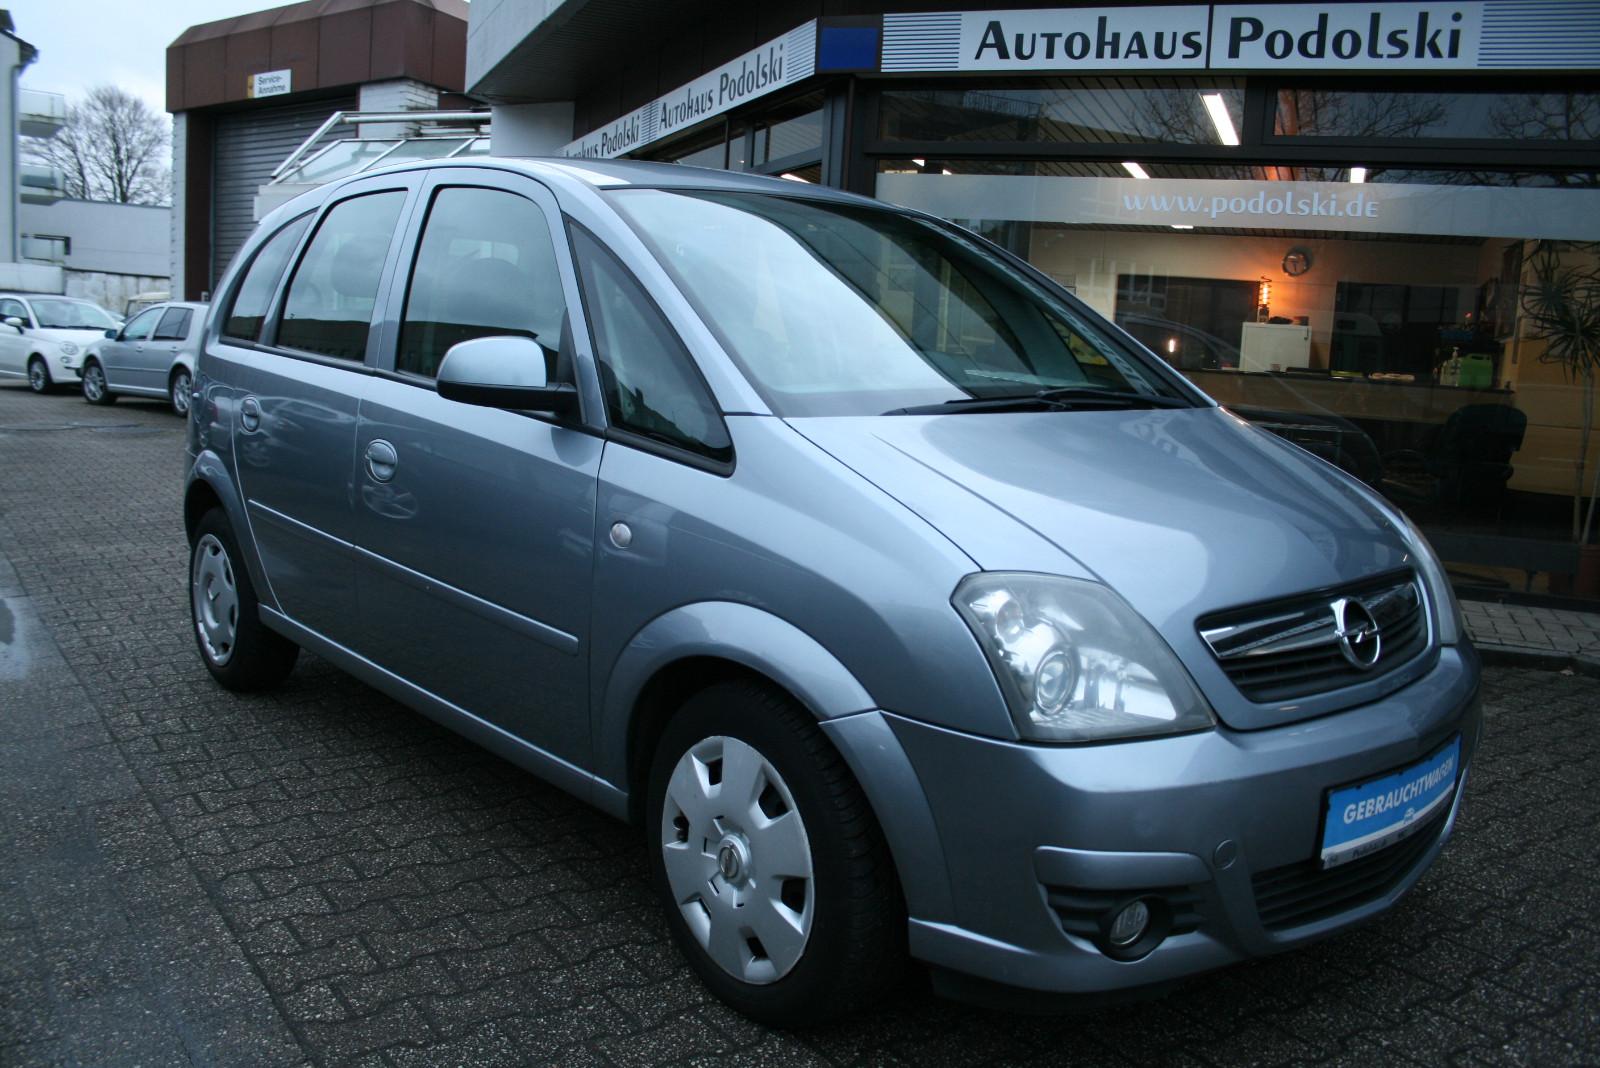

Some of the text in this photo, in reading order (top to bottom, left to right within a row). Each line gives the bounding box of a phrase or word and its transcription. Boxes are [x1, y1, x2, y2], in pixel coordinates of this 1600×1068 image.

[1227, 11, 1463, 60] Podolski
[718, 42, 784, 106] Podolski
[600, 114, 641, 157] Podolski
[1122, 190, 1380, 219] www.podolski.de
[1342, 754, 1456, 825] GEBRAUCHTWAGEN
